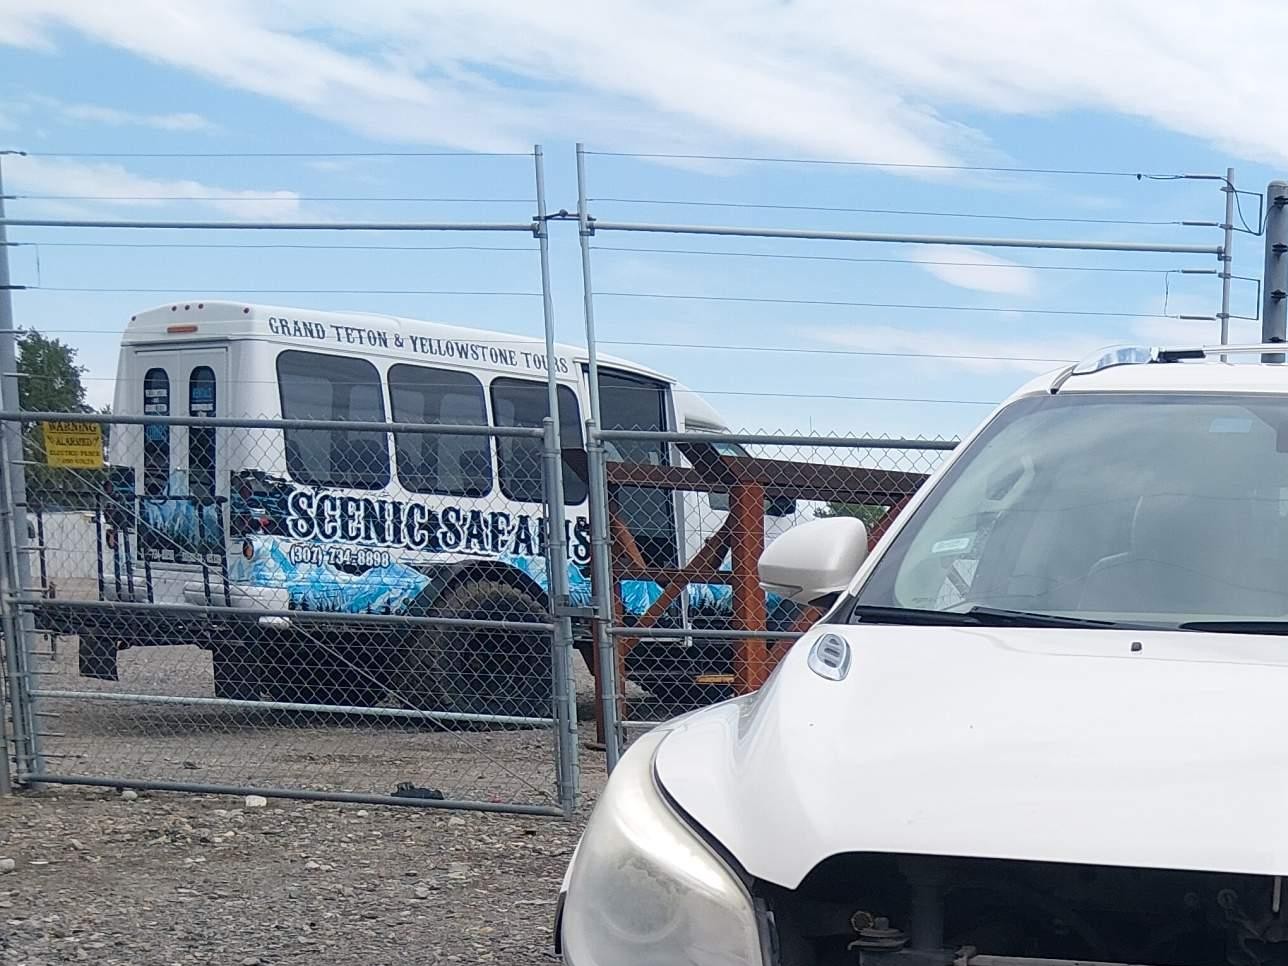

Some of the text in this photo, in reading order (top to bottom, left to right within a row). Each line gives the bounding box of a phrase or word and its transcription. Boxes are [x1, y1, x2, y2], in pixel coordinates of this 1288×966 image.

[268, 316, 326, 340] GRAND
[330, 324, 388, 348] TETON
[394, 333, 404, 348] &
[409, 335, 518, 367] YELLOWSTONE
[290, 493, 592, 563] SCENIC SAFAIS
[290, 543, 390, 569] (307) 734-8898
